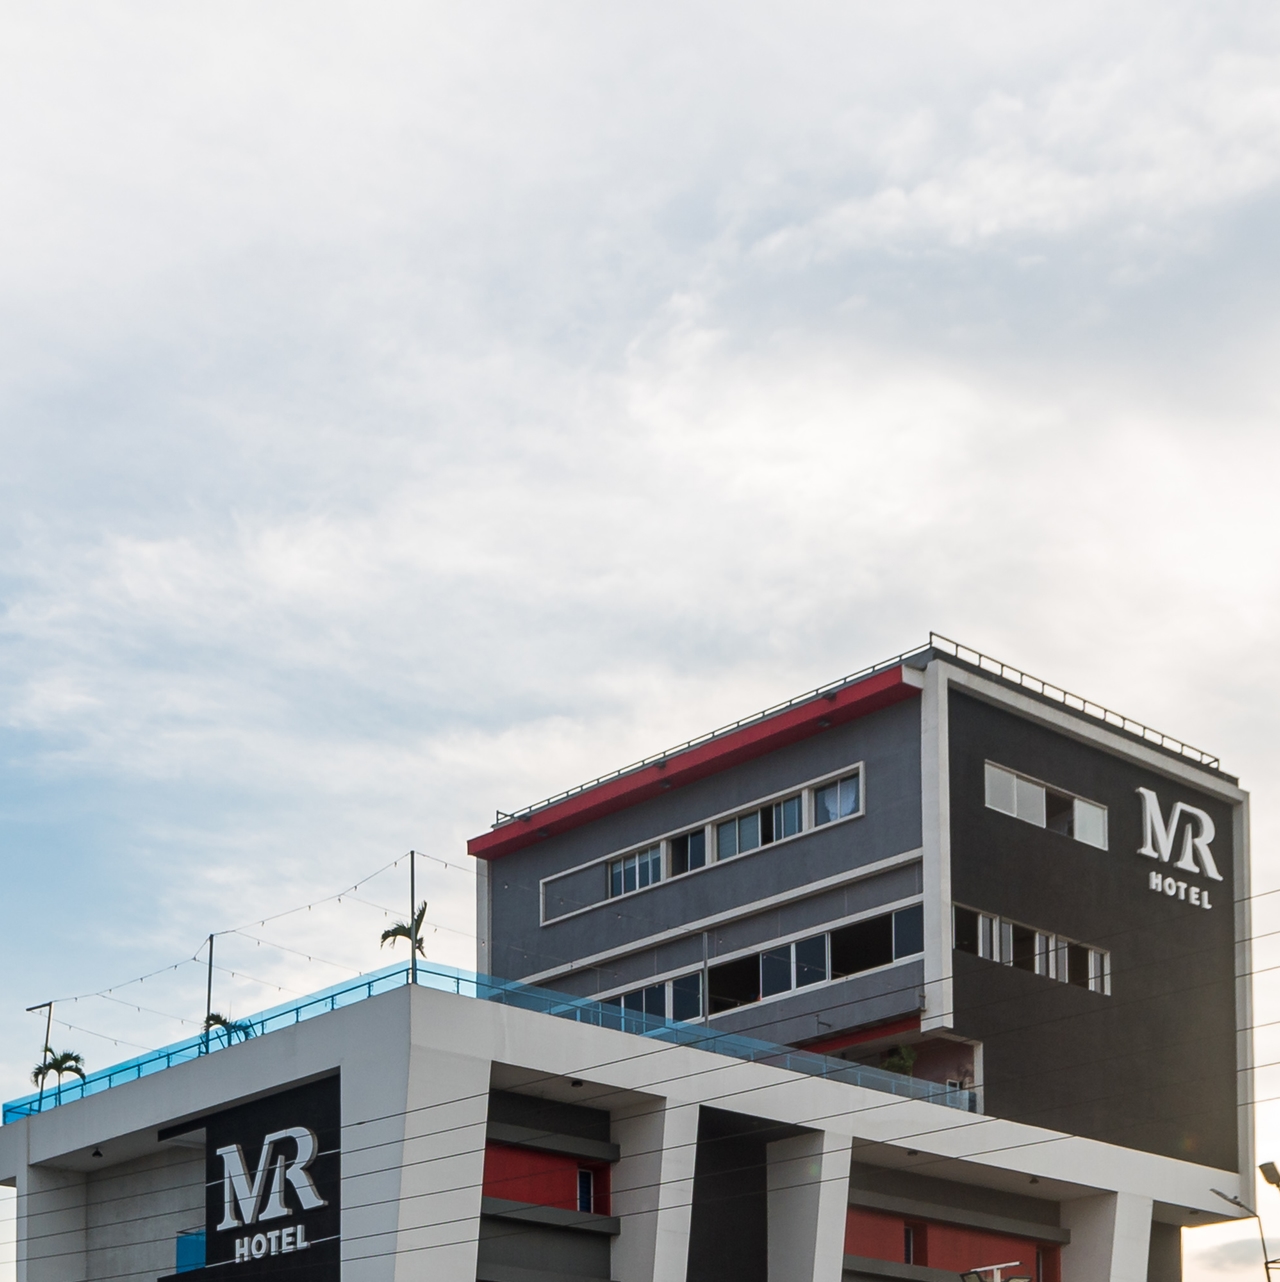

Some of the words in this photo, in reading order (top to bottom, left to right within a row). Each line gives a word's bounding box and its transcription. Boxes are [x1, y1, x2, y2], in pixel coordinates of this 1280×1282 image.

[1135, 786, 1223, 881] MR
[1149, 871, 1212, 909] HOTEL
[216, 1126, 328, 1231] MR
[235, 1224, 310, 1263] HOTEL
